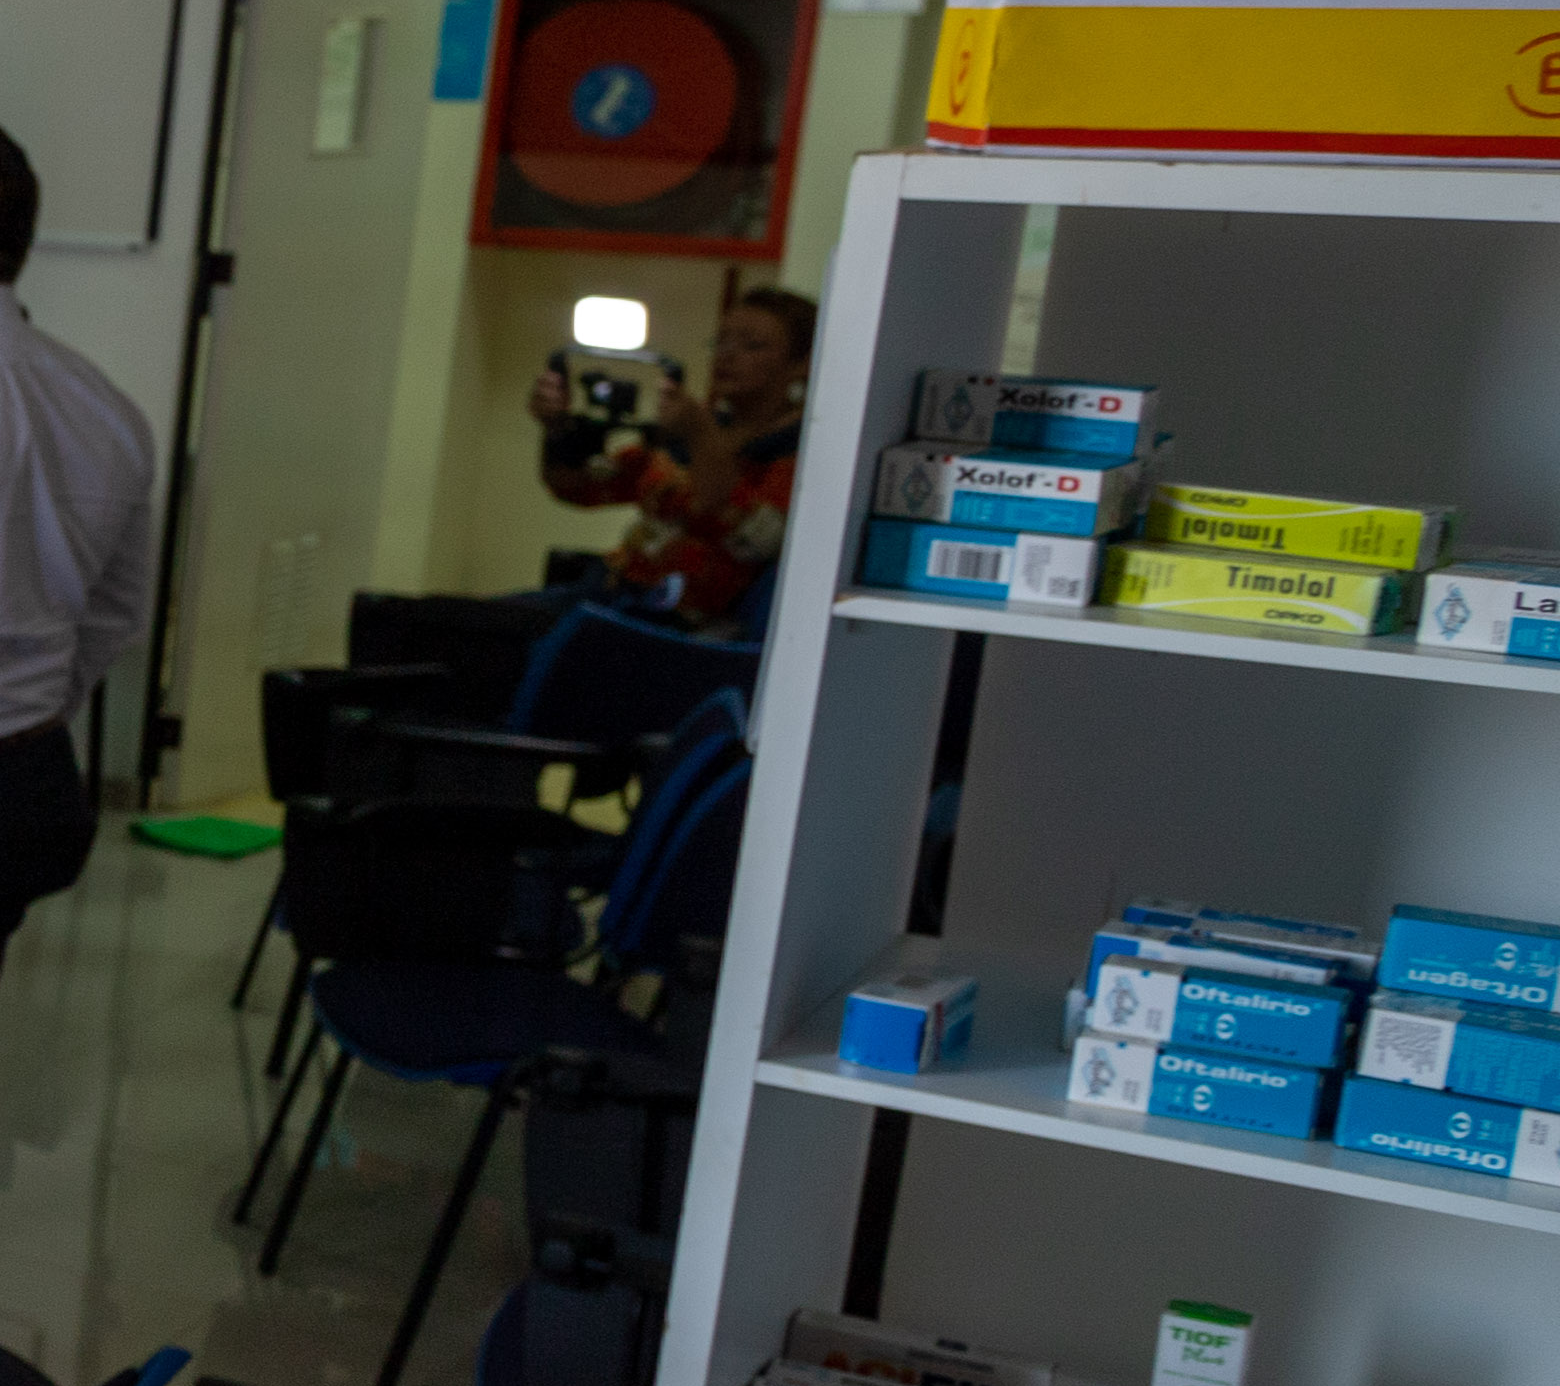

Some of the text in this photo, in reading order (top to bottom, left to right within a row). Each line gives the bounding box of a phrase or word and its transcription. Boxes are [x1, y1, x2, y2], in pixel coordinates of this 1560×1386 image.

[1182, 517, 1286, 551] Timolol
[1226, 565, 1336, 600] Timolol
[1181, 982, 1311, 1016] Oftalirio
[1407, 968, 1548, 1004] Oftagen
[1158, 1054, 1288, 1088] Oftalirio
[1370, 1133, 1507, 1171] Oftalirio
[1171, 1325, 1233, 1348] TIOF
